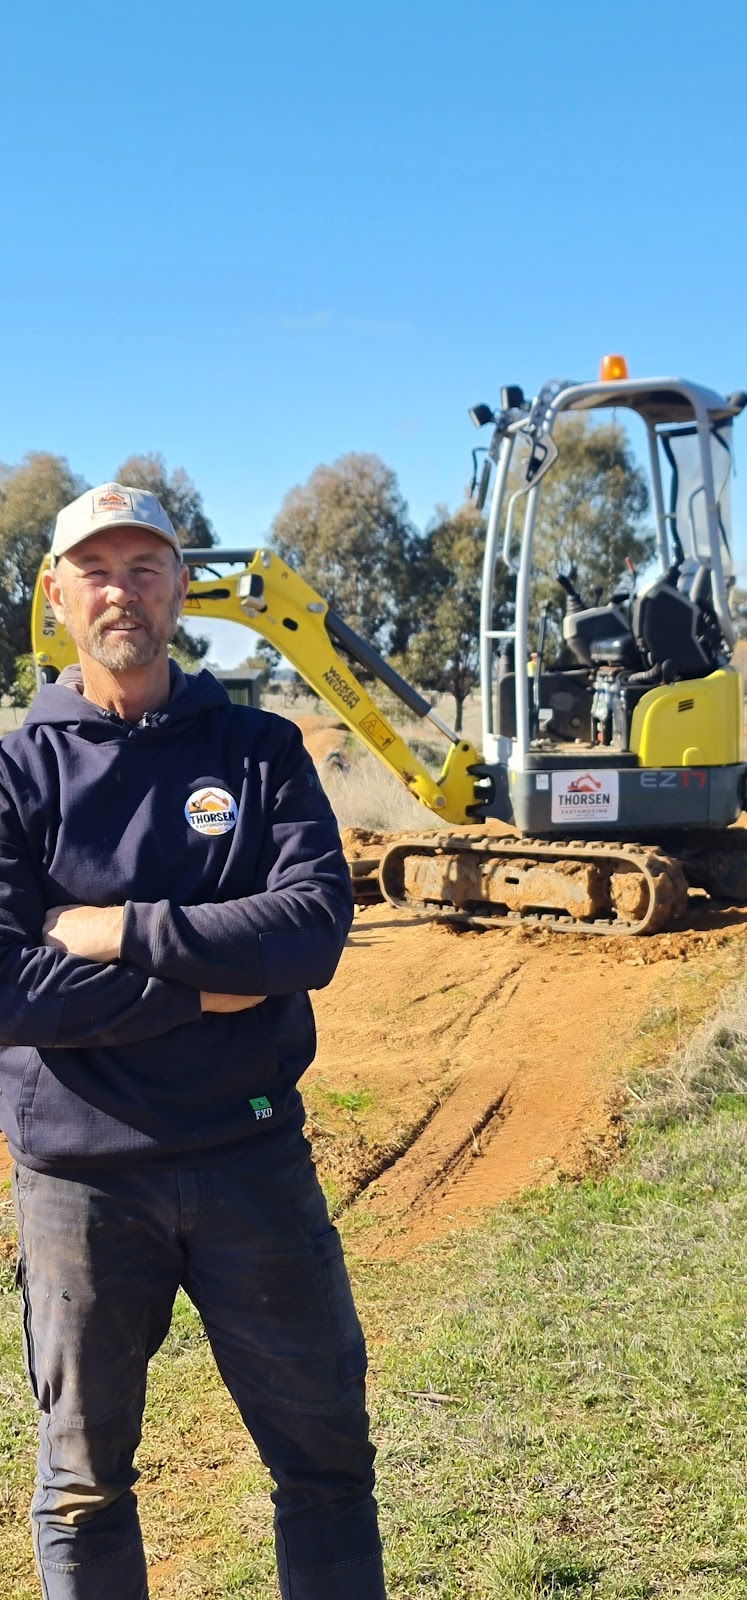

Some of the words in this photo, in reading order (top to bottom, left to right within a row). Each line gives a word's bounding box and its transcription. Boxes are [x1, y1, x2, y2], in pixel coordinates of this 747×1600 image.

[322, 671, 356, 710] NEUSON
[329, 665, 360, 704] WACKER
[640, 771, 706, 788] EZ17
[558, 793, 610, 806] THORSEN
[190, 811, 236, 825] THORSEN
[255, 1107, 273, 1121] FXD
